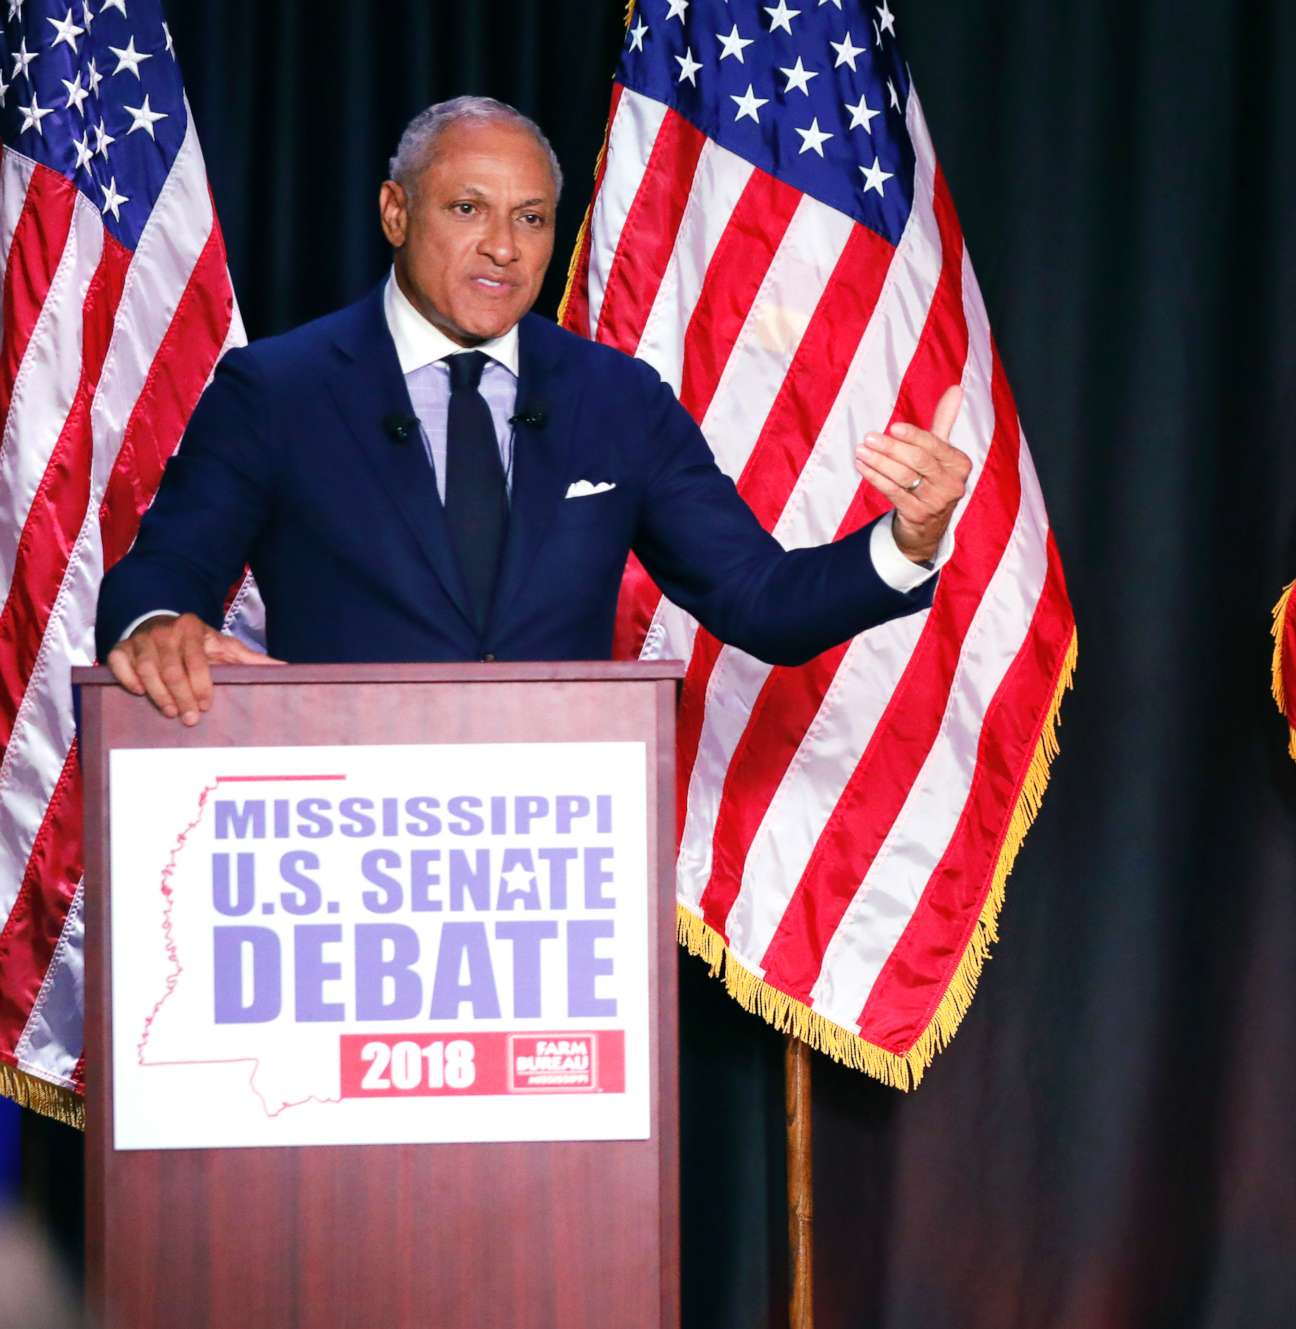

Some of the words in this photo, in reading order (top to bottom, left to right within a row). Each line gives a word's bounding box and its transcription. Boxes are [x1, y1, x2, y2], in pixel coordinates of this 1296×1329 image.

[213, 794, 613, 840] MISSISSIPPI
[211, 849, 341, 917] U.S.
[360, 846, 617, 914] SENATE
[212, 919, 618, 1025] DEBATE
[360, 1040, 476, 1090] 2018
[516, 1055, 590, 1071] BUREAU
[536, 1040, 588, 1056] FARM
